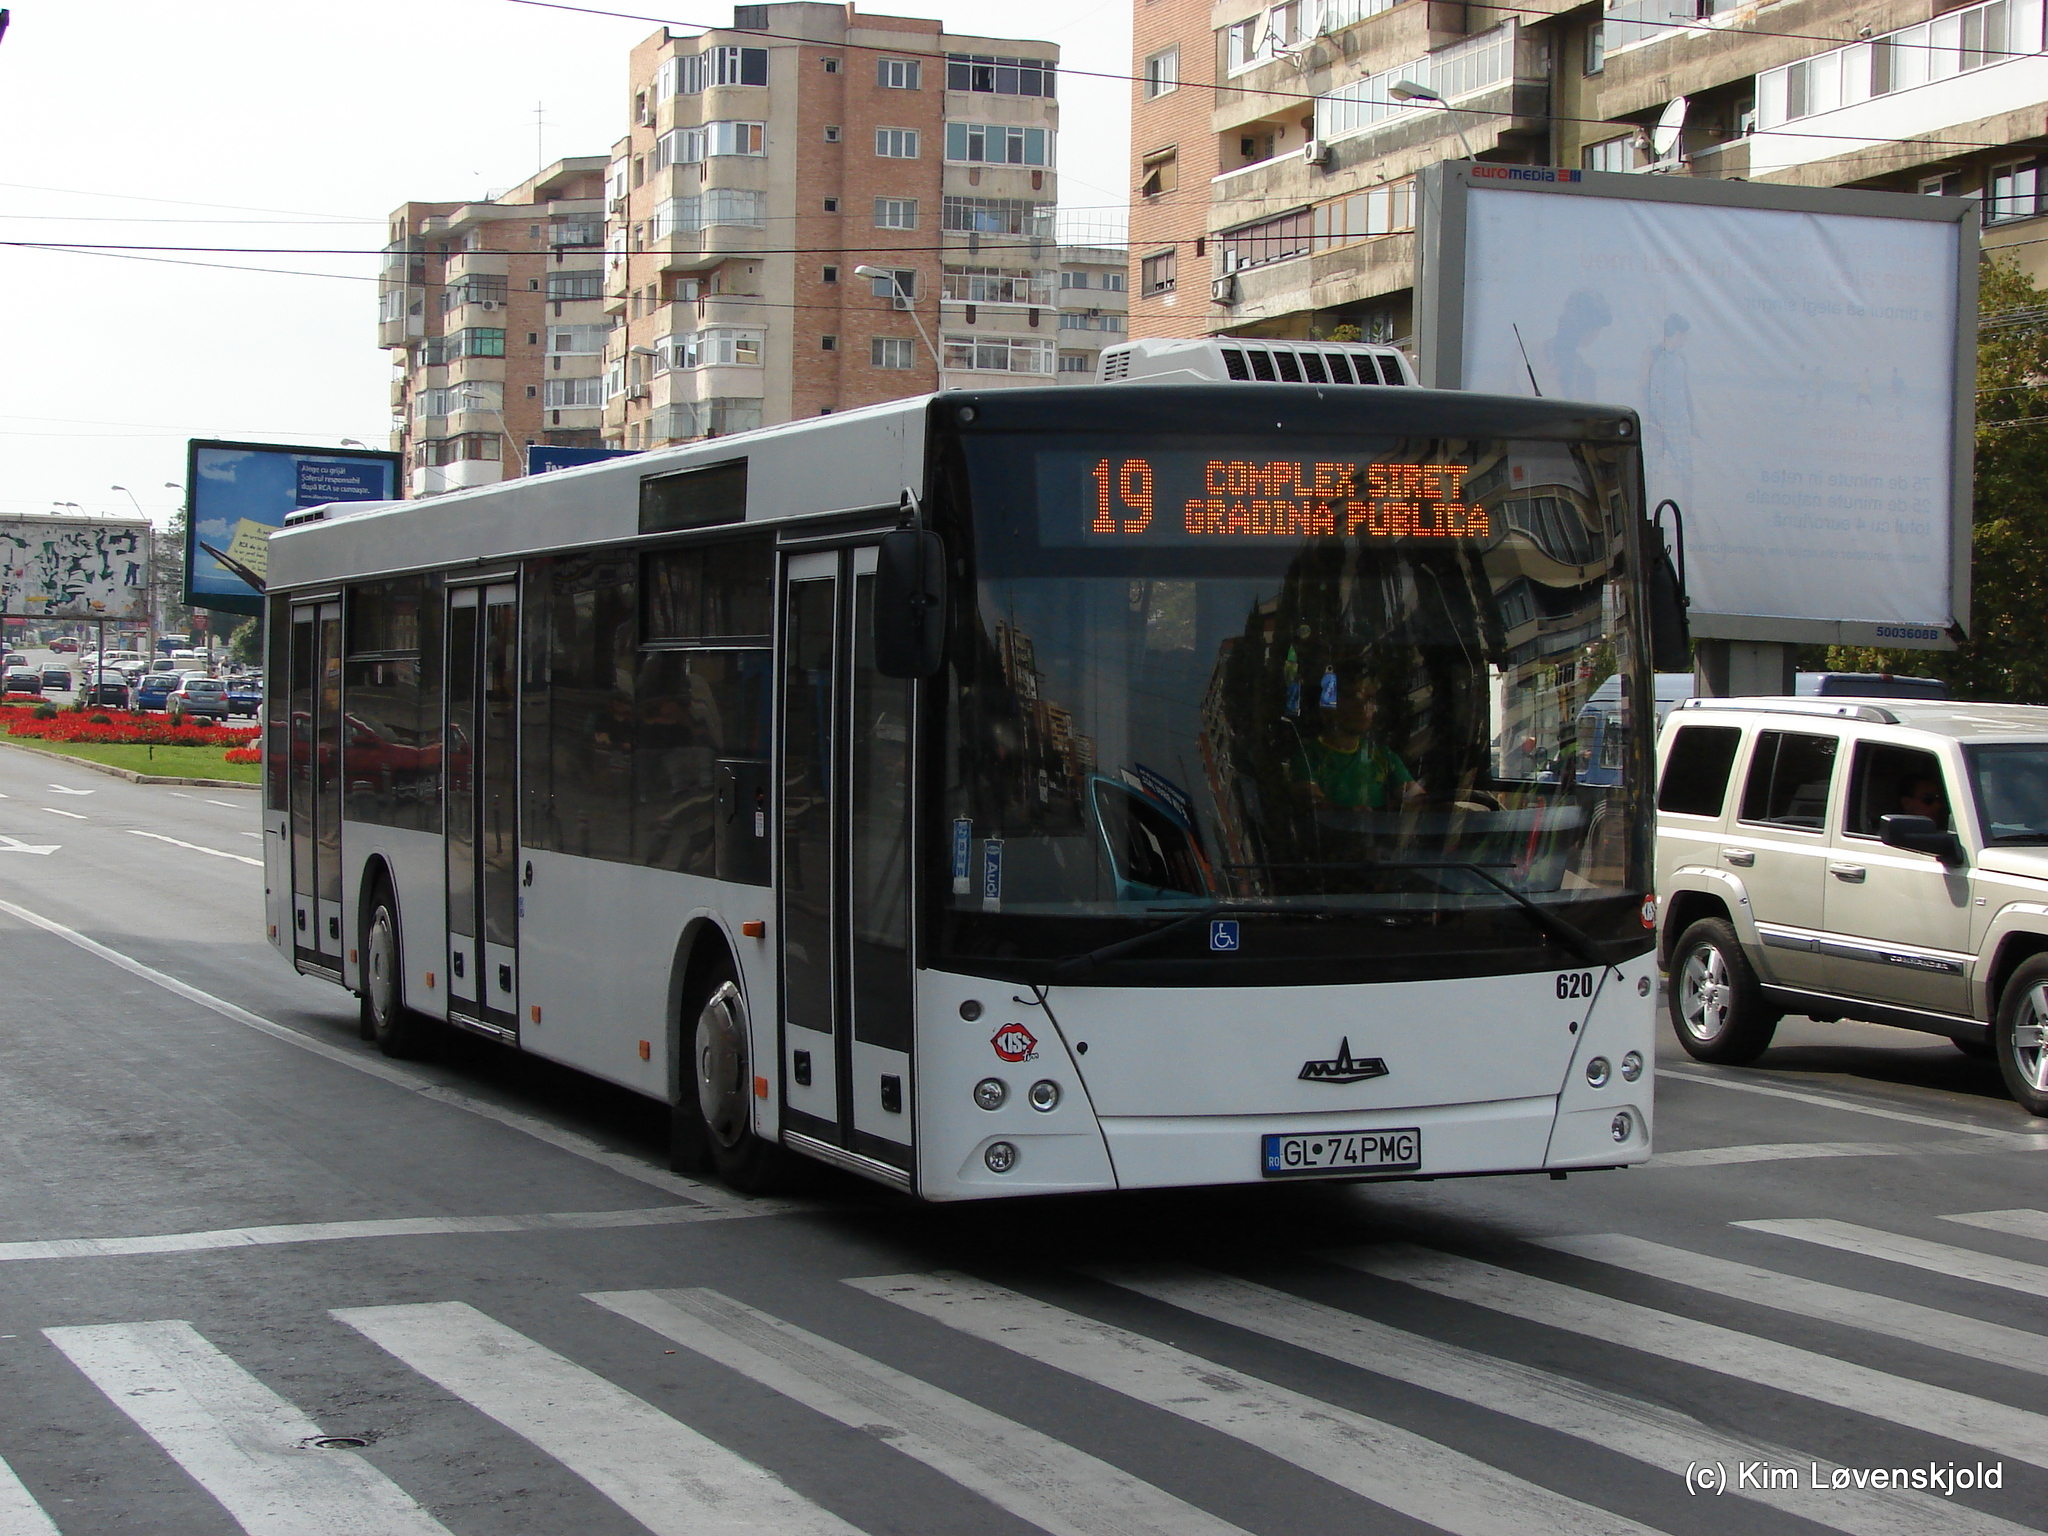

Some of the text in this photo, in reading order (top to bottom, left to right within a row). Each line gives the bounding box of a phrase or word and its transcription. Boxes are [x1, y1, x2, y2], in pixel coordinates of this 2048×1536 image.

[1092, 458, 1469, 534] 19 COMPLEX SIRET
[1185, 499, 1490, 538] GRADINA PUBLICA
[1876, 626, 1939, 640] 5003608B
[1889, 955, 1949, 970] COMMANDER
[1556, 972, 1592, 999] 620
